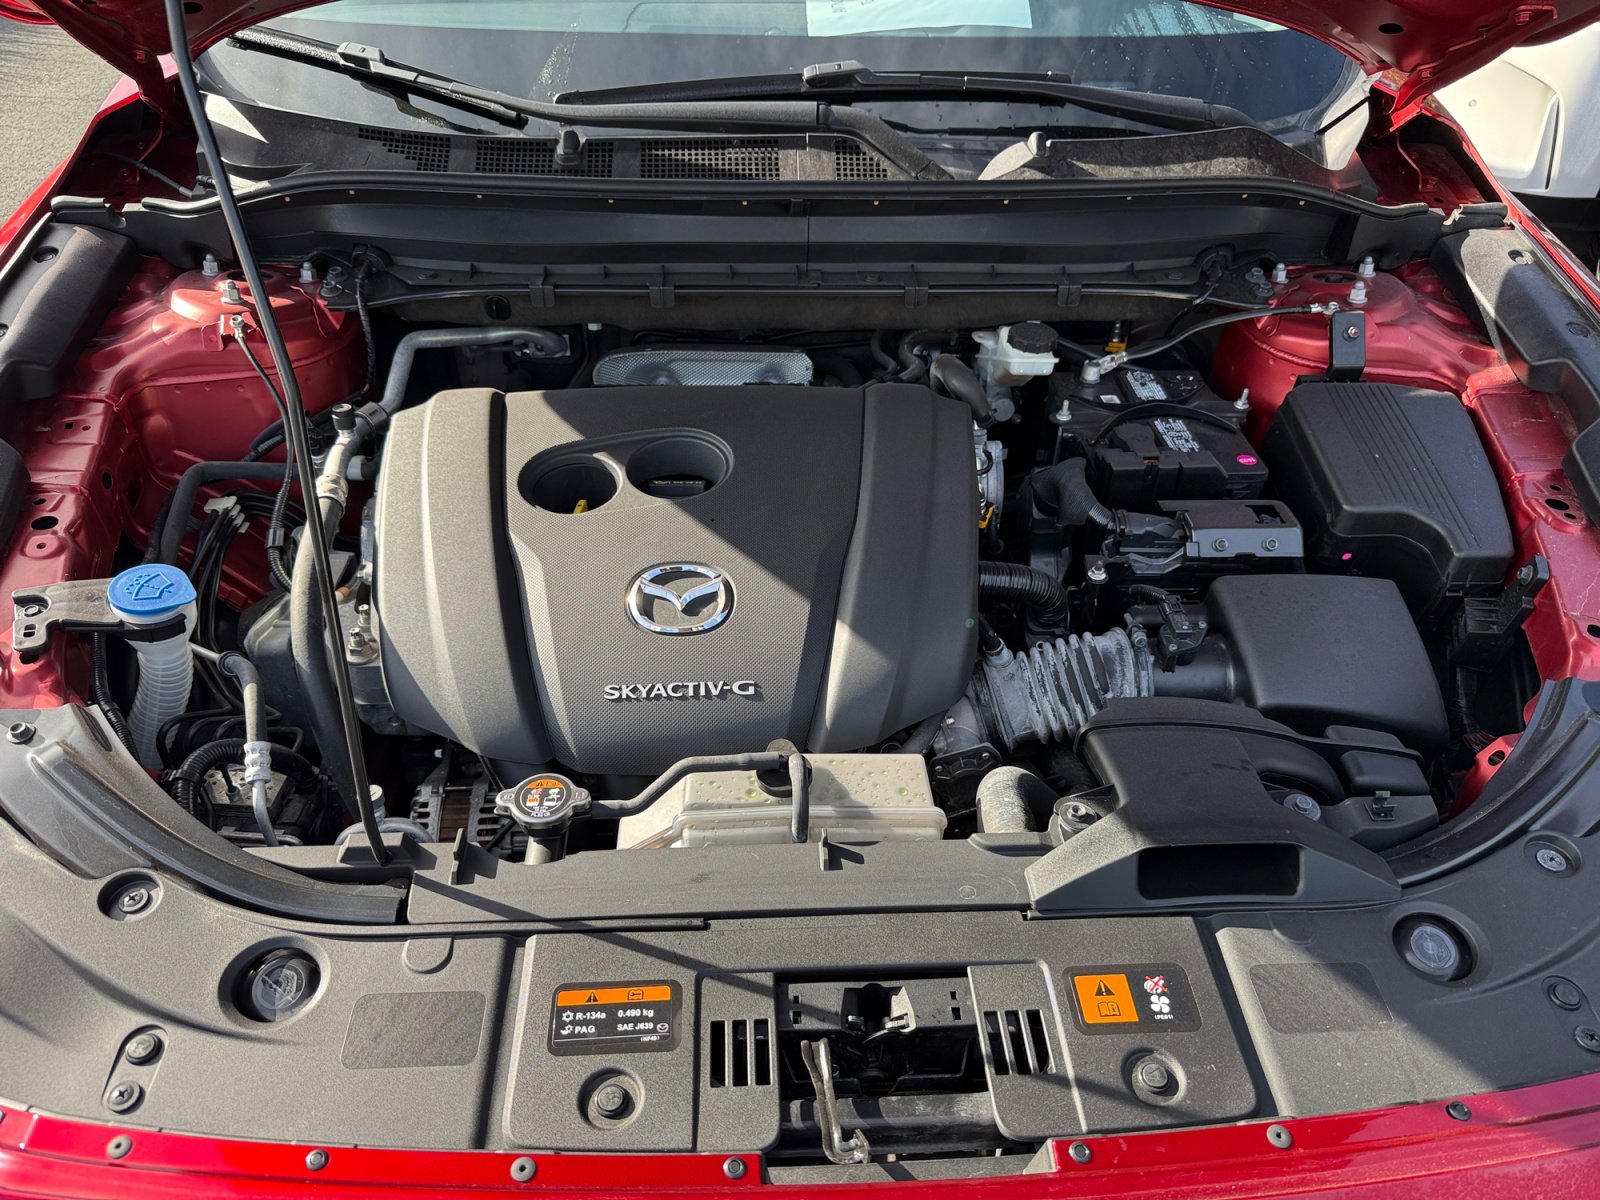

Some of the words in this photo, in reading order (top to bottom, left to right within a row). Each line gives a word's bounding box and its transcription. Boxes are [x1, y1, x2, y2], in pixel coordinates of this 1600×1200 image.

[604, 681, 755, 699] SKYACTIV-G
[575, 1011, 606, 1020] R-134a
[617, 1009, 641, 1017] 0.490
[642, 1008, 654, 1018] kg
[574, 1025, 596, 1034] PAG
[617, 1023, 634, 1031] SAE
[635, 1022, 654, 1030] J639
